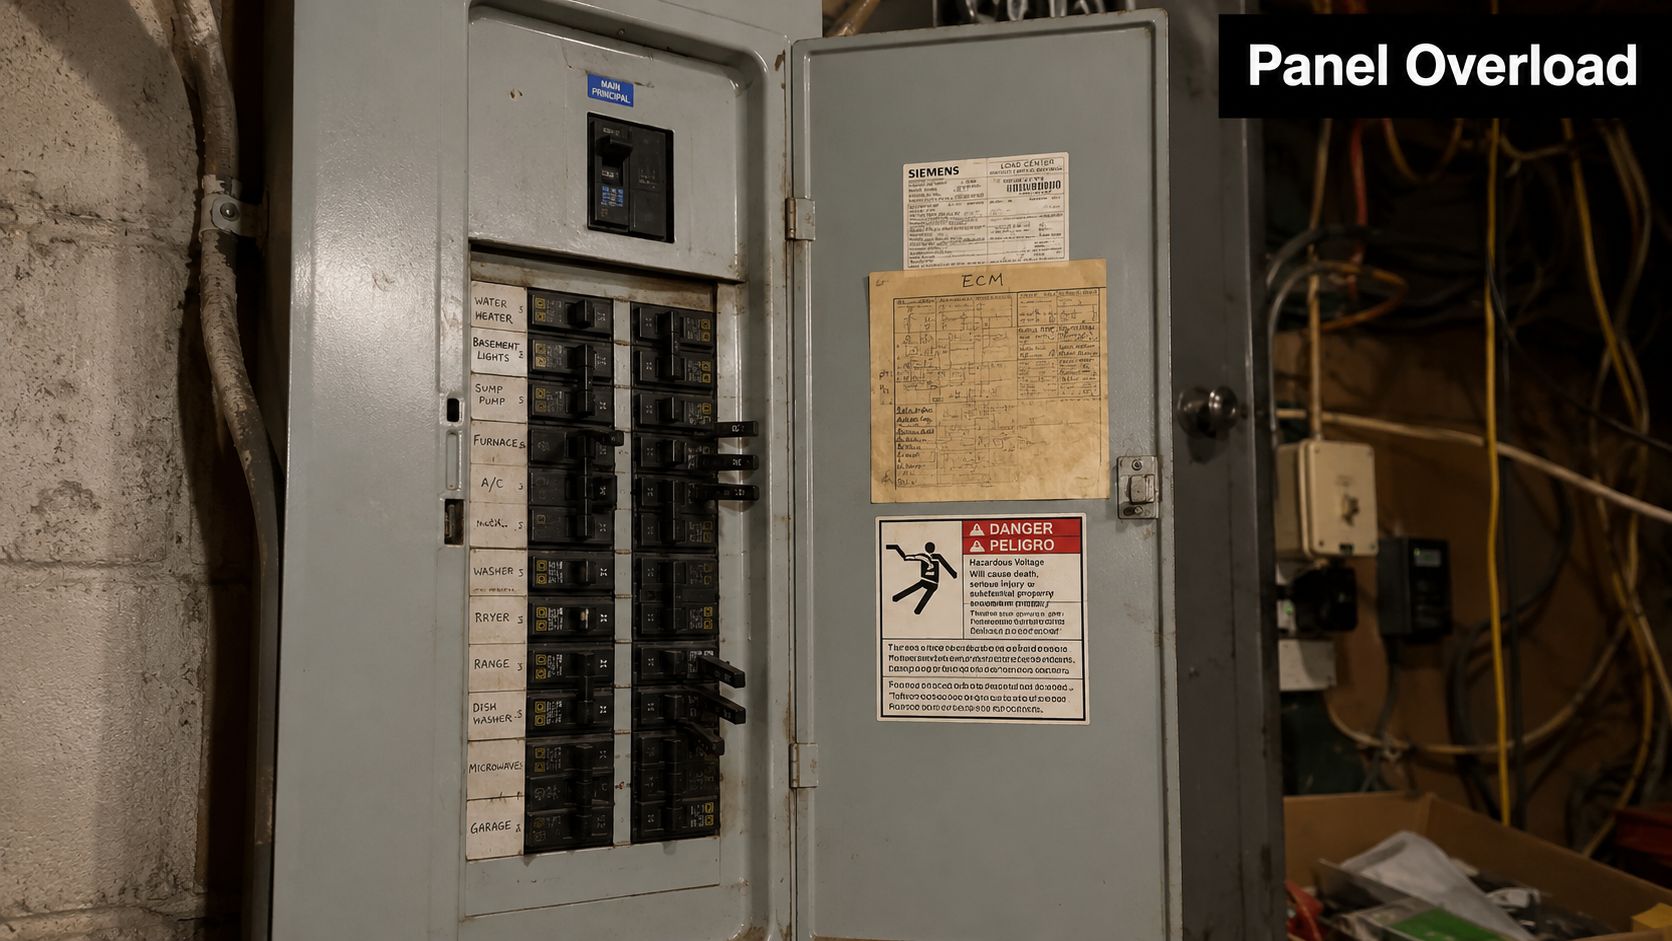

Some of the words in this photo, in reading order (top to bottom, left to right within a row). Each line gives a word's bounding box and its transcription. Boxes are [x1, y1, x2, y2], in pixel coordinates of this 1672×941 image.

[600, 80, 621, 92] MAIN
[592, 87, 631, 104] PRINCIPAL
[908, 166, 960, 179] SIEMENS
[961, 273, 1004, 288] ECM
[474, 296, 507, 308] WATER
[475, 311, 513, 324] HEATER
[472, 336, 520, 351] BASEMENT
[477, 350, 510, 363] LIGHTS
[475, 383, 503, 394] SUMP
[479, 396, 506, 406] PUMP
[480, 476, 504, 493] A/C
[989, 522, 1053, 535] DANGER
[990, 539, 1055, 551] PELIGRO
[969, 558, 1013, 567] Hazardous
[1014, 558, 1045, 568] Voltage
[473, 566, 514, 576] WASHER
[969, 570, 985, 578] Will
[1013, 570, 1039, 578] death,
[474, 659, 510, 670] RANGE
[472, 702, 497, 713] DISH
[472, 713, 513, 725] WASHER
[470, 820, 512, 835] GARAGE
